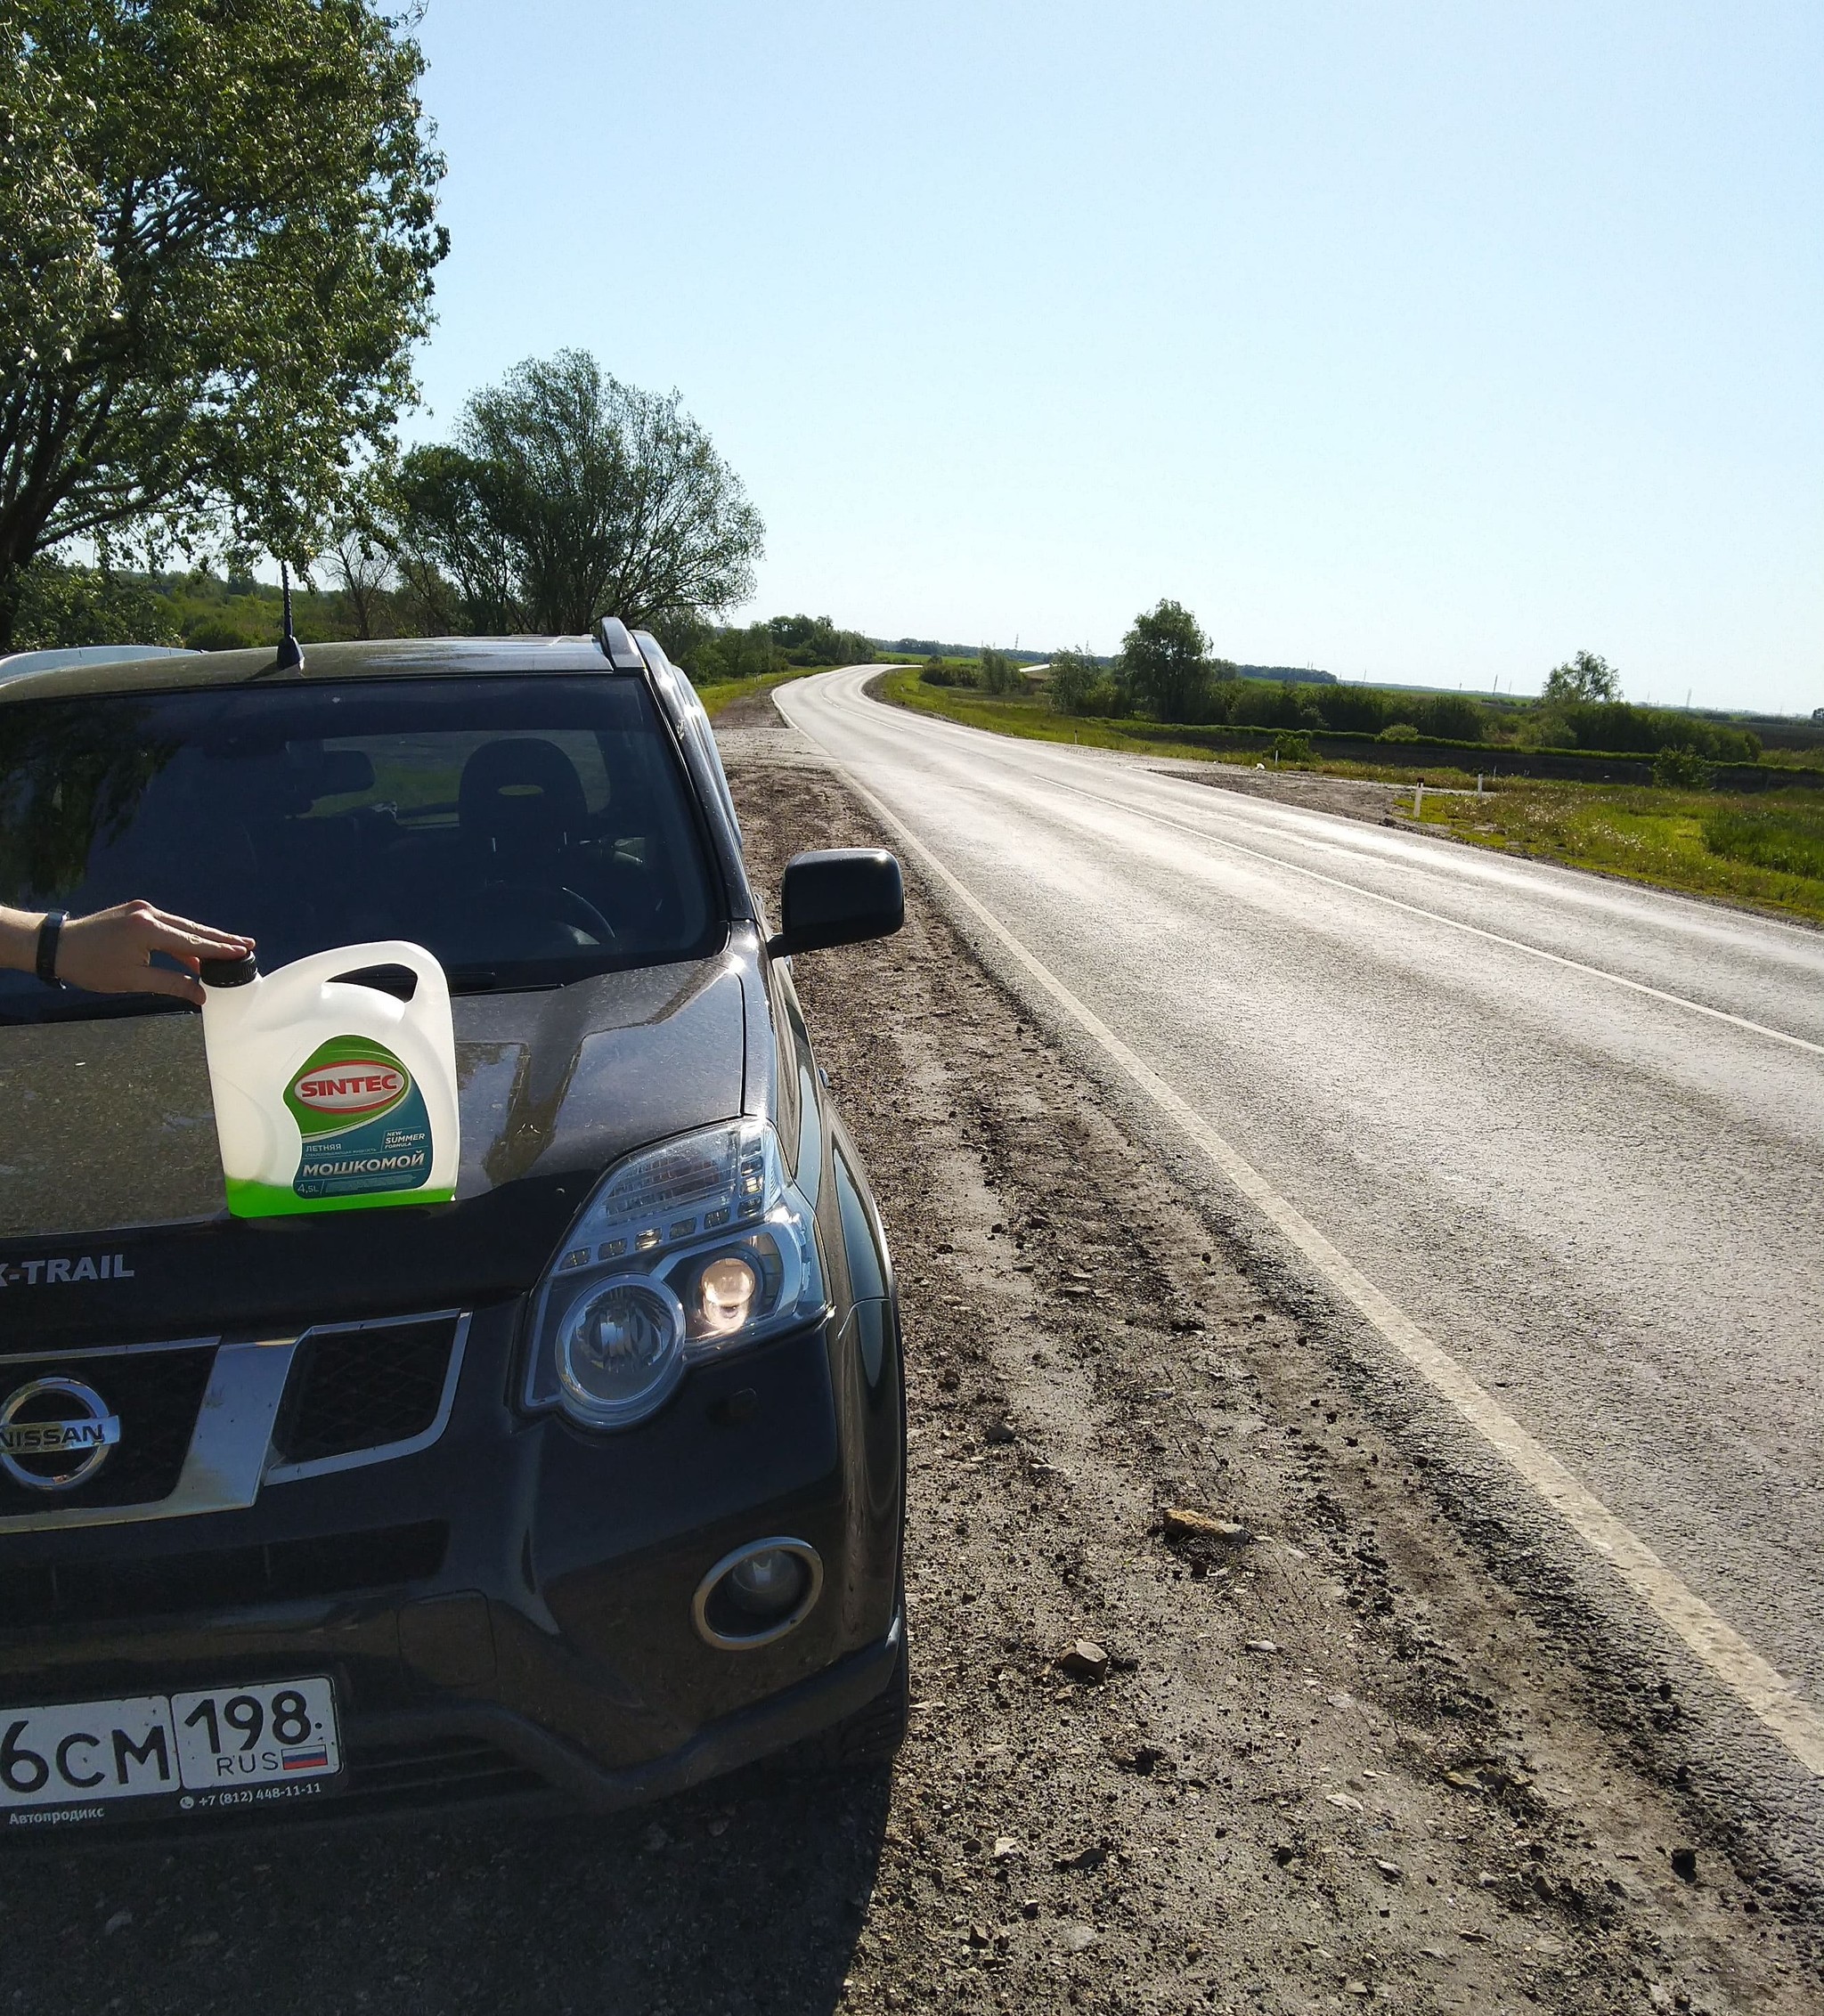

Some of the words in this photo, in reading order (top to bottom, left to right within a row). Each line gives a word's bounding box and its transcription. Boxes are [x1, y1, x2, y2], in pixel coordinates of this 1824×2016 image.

[301, 1074, 398, 1097] SINTEC
[305, 1143, 342, 1152] ЛЕТНЯЯ
[385, 1133, 426, 1144] SUMMER
[303, 1150, 426, 1176] МОШКОМОЙ
[0, 1425, 104, 1448] NISSAN
[184, 1690, 311, 1753] 198
[216, 1752, 278, 1776] RUS
[199, 1795, 216, 1806] +7
[219, 1790, 254, 1805] (812)
[256, 1783, 322, 1801] 448-11-11
[9, 1806, 104, 1825] Автопродикс
